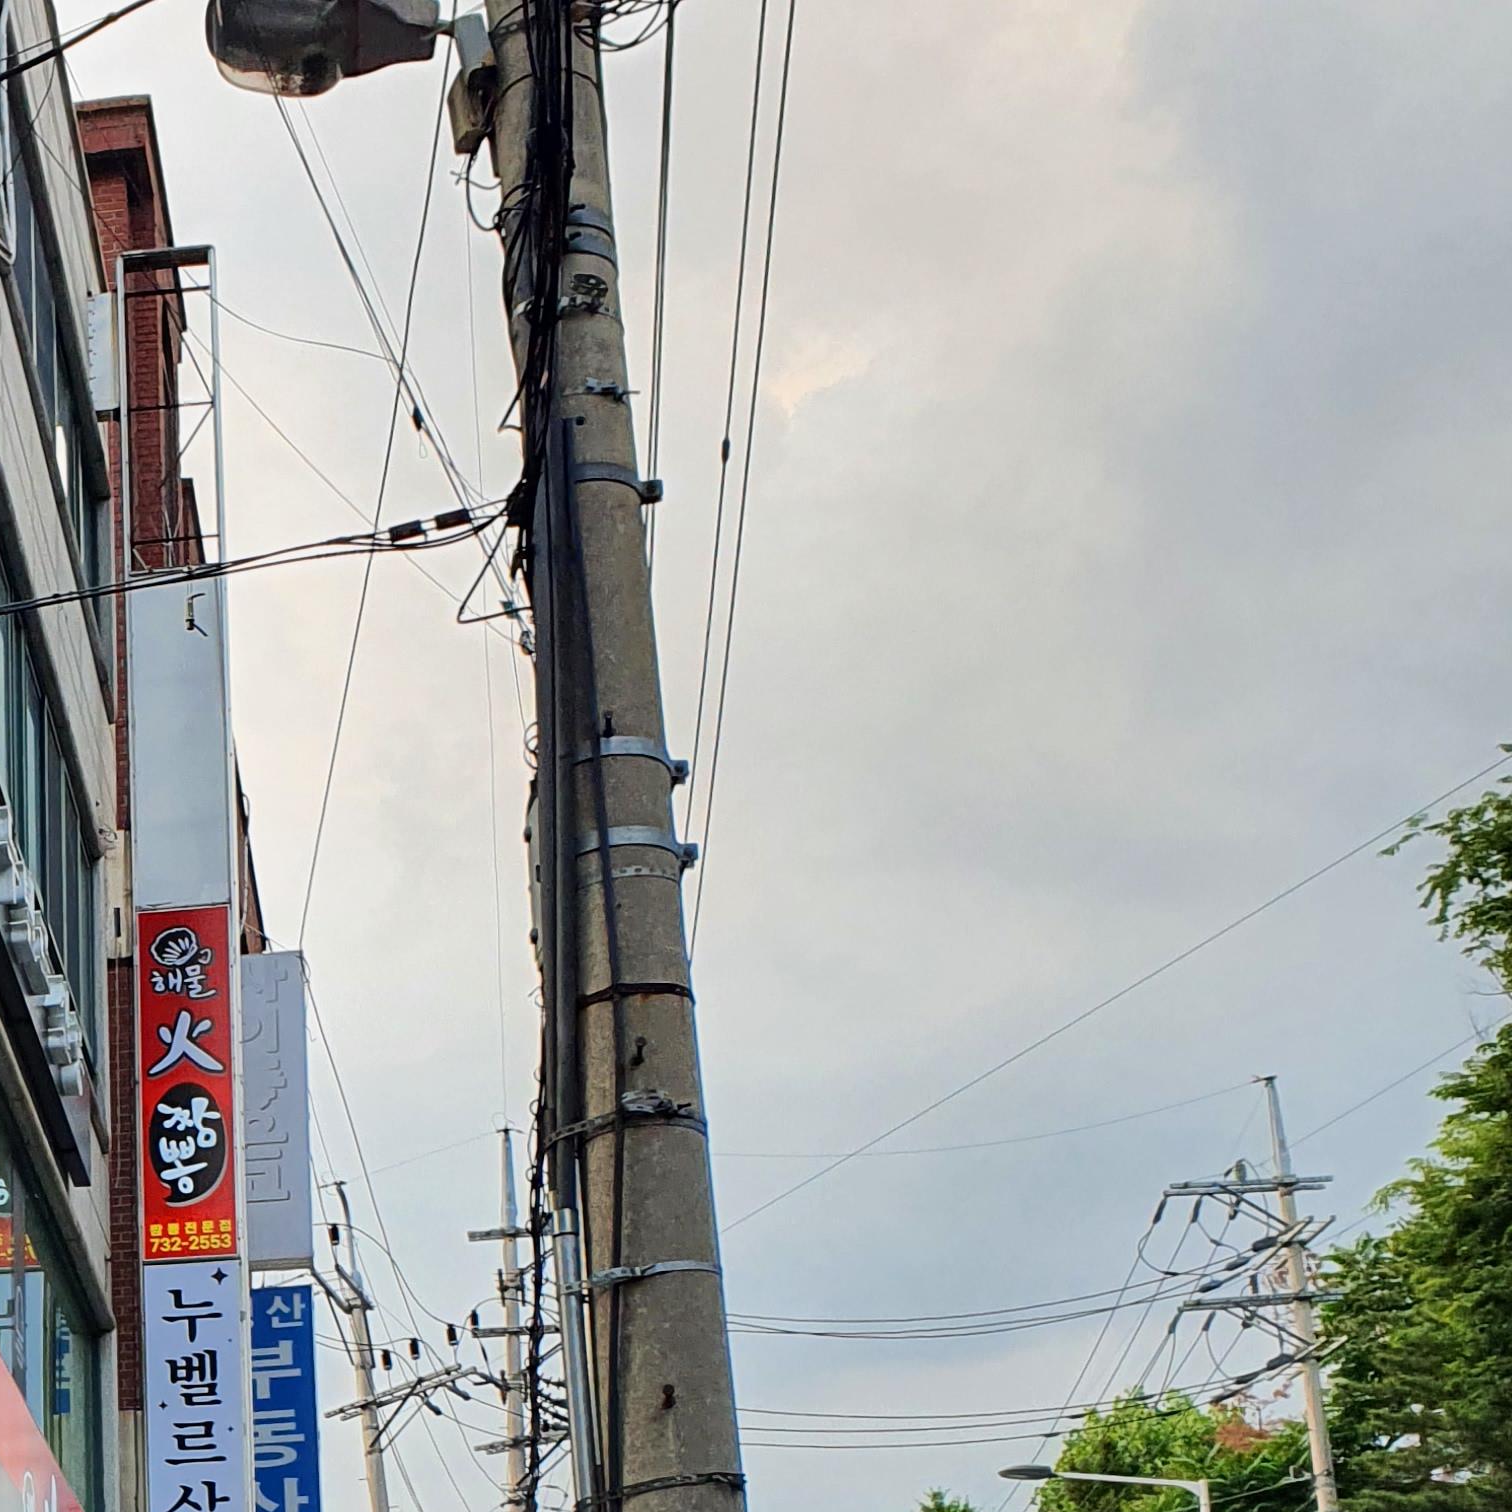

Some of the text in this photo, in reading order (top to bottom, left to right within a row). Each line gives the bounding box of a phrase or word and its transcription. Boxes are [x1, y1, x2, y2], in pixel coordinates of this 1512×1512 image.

[151, 965, 217, 999] 해물
[148, 1009, 226, 1079] 火
[149, 1233, 233, 1253] 732-2553
